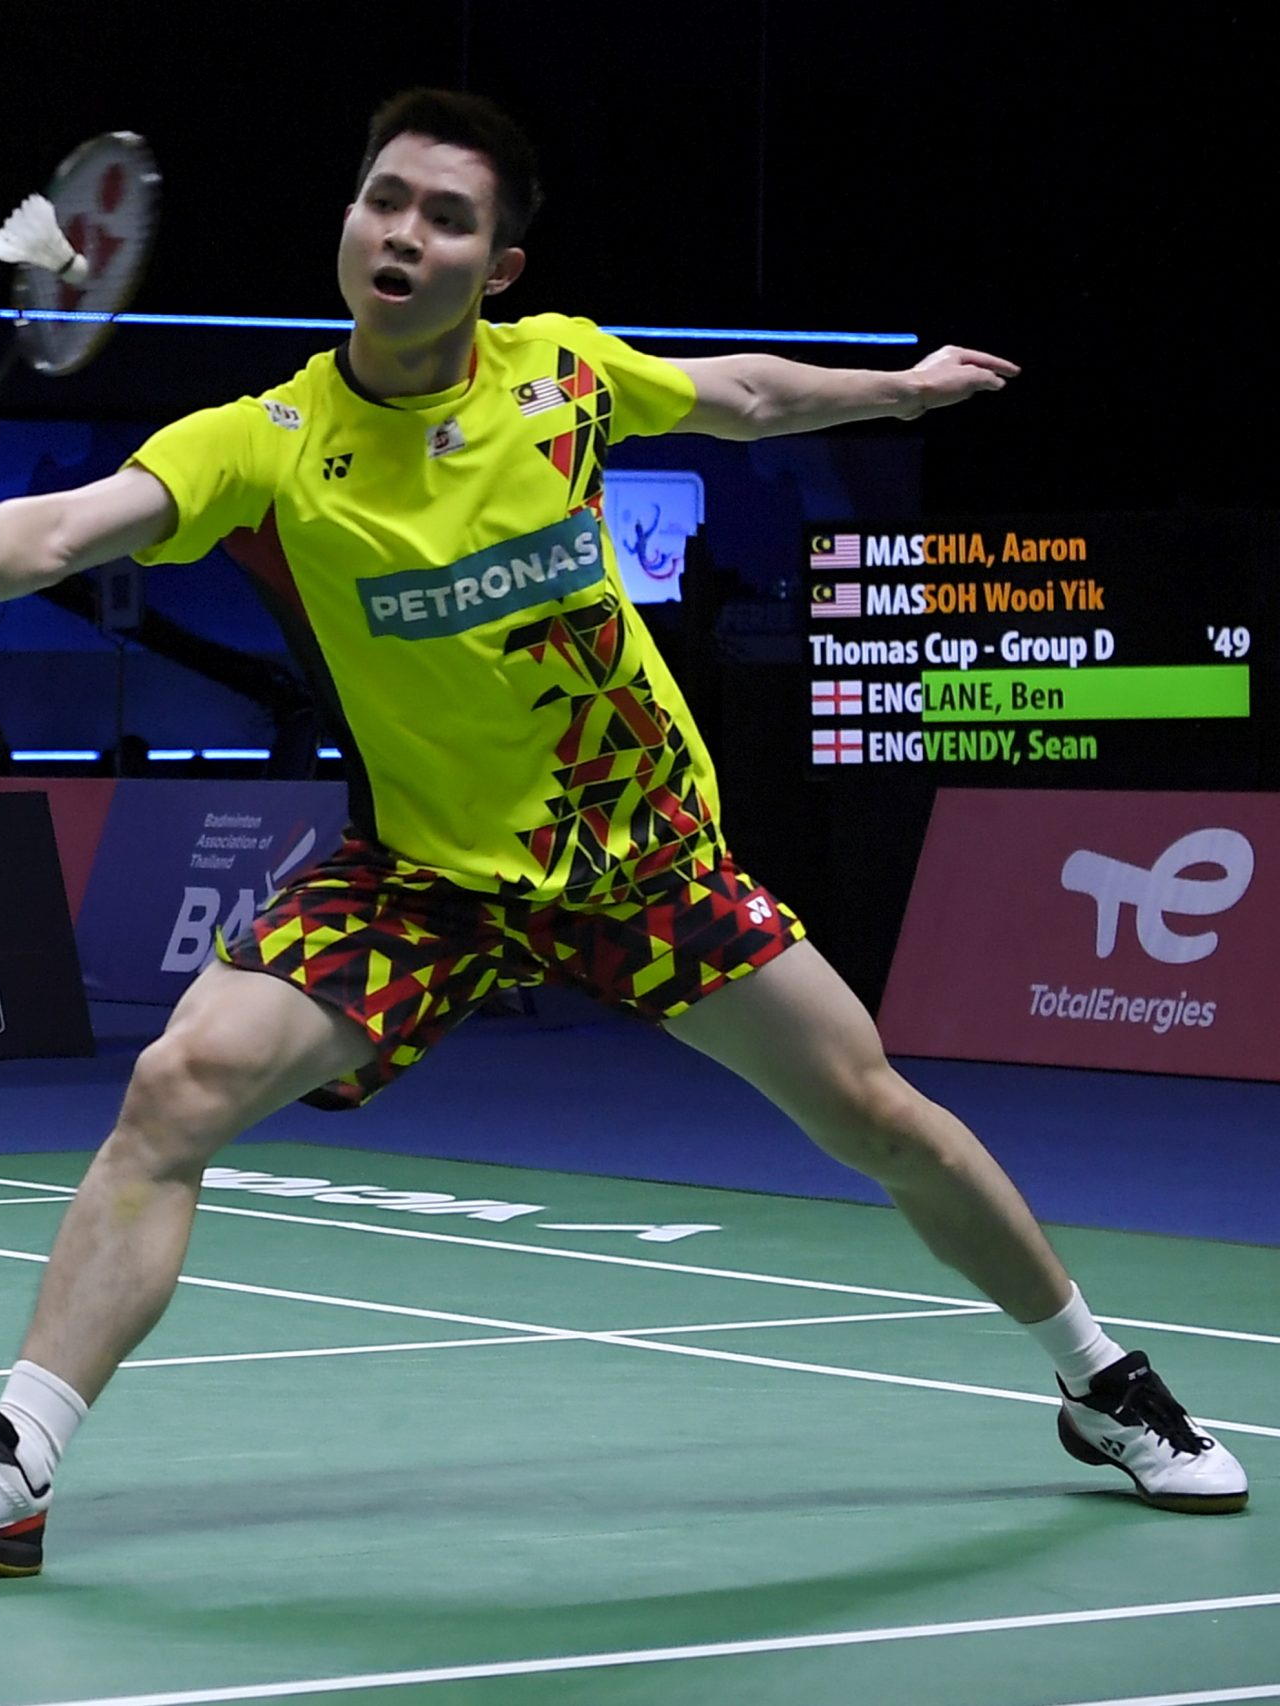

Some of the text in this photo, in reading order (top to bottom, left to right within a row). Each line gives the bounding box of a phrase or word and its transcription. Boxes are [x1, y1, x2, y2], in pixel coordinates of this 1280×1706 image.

[866, 533, 1087, 568] MAS CHIA, Aaron
[370, 530, 599, 624] PETRONAS
[867, 580, 1105, 616] MAS SOH Wooi Yik
[809, 635, 919, 666] Thomas
[924, 633, 978, 670] Cup
[1001, 630, 1087, 669] Group
[1094, 628, 1115, 660] D
[868, 682, 1065, 714] ENG LANE, Ben
[869, 730, 1098, 765] ENG VENDY, Sean
[204, 813, 262, 829] Badminton
[196, 834, 274, 850] Association of
[189, 854, 236, 870] Thailand
[1029, 984, 1218, 1034] TotalEnergies
